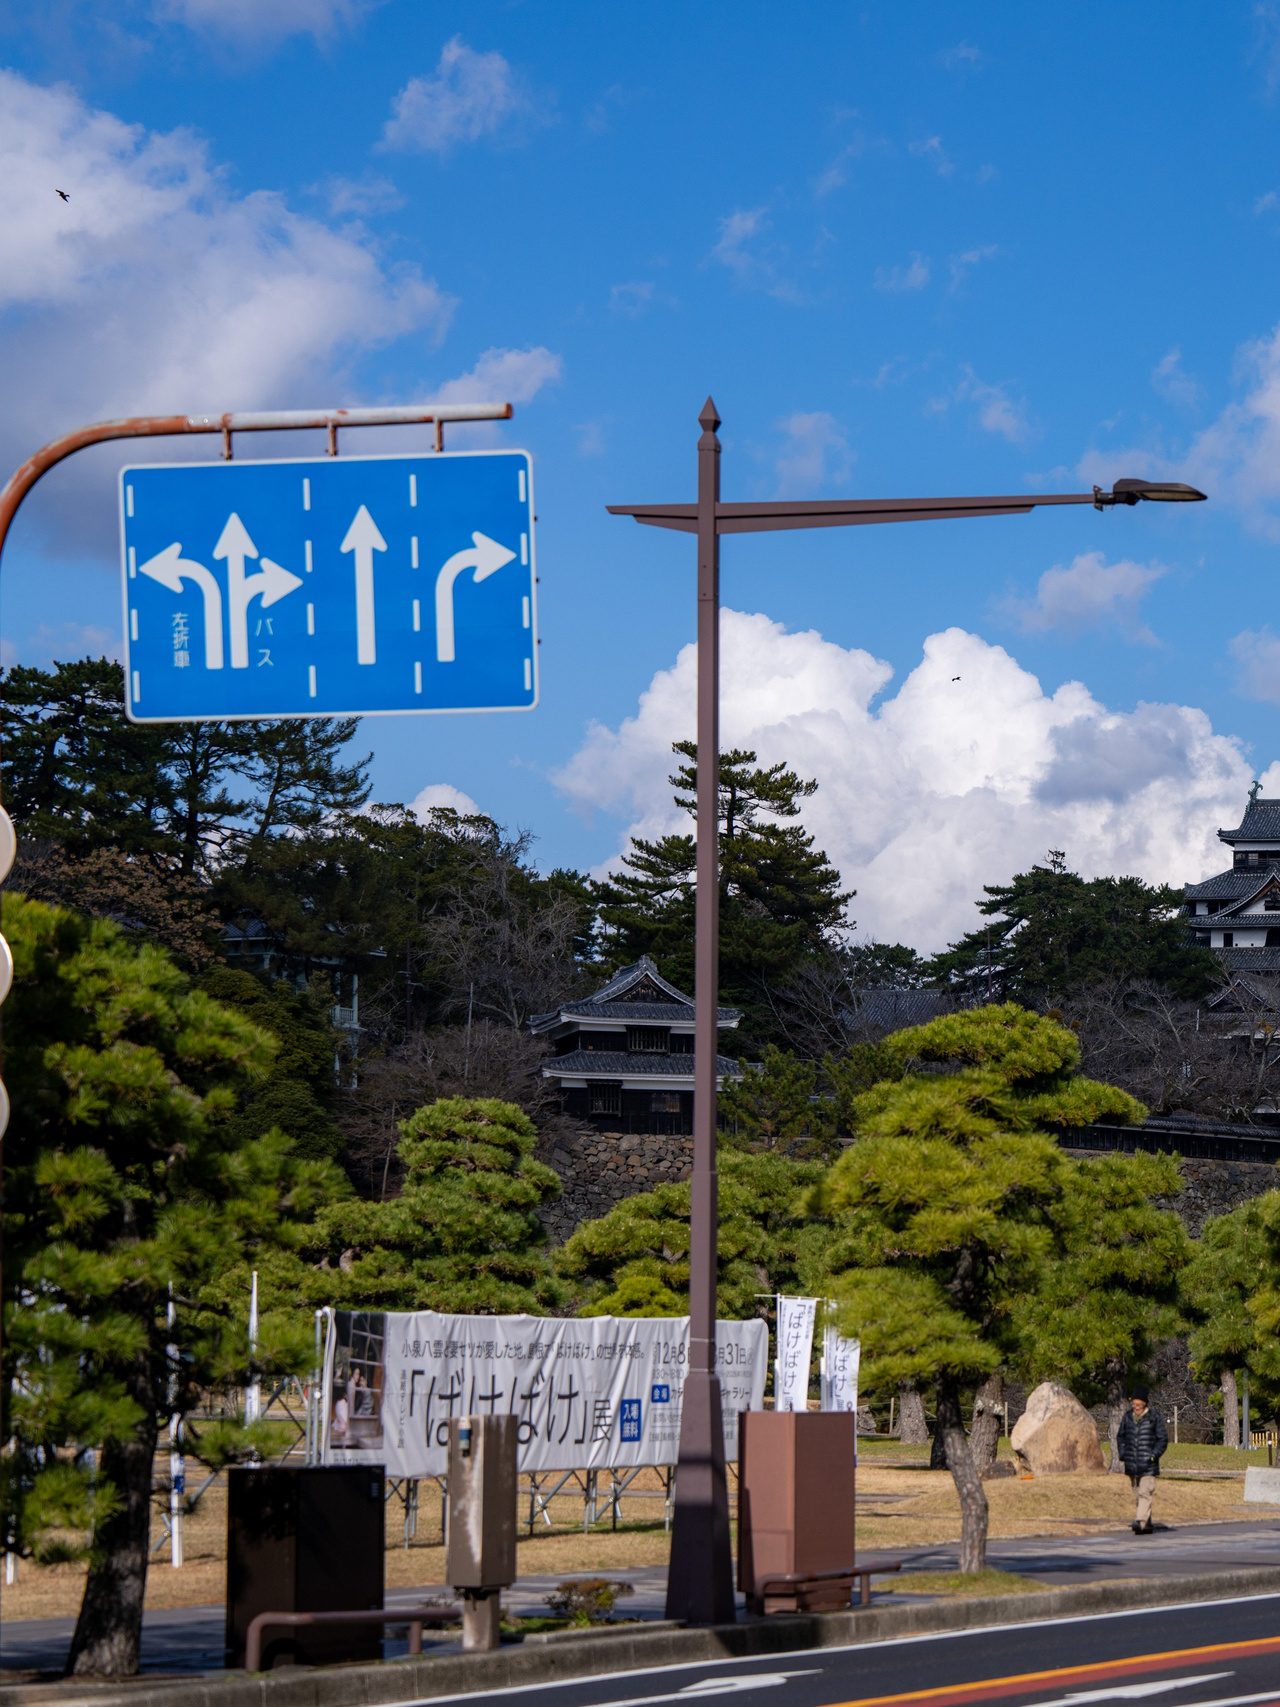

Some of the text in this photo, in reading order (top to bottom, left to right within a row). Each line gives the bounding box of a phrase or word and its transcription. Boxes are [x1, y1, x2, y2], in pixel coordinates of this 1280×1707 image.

[172, 612, 191, 669] 左折車
[255, 618, 274, 667] バス
[657, 1342, 690, 1365] 12月8
